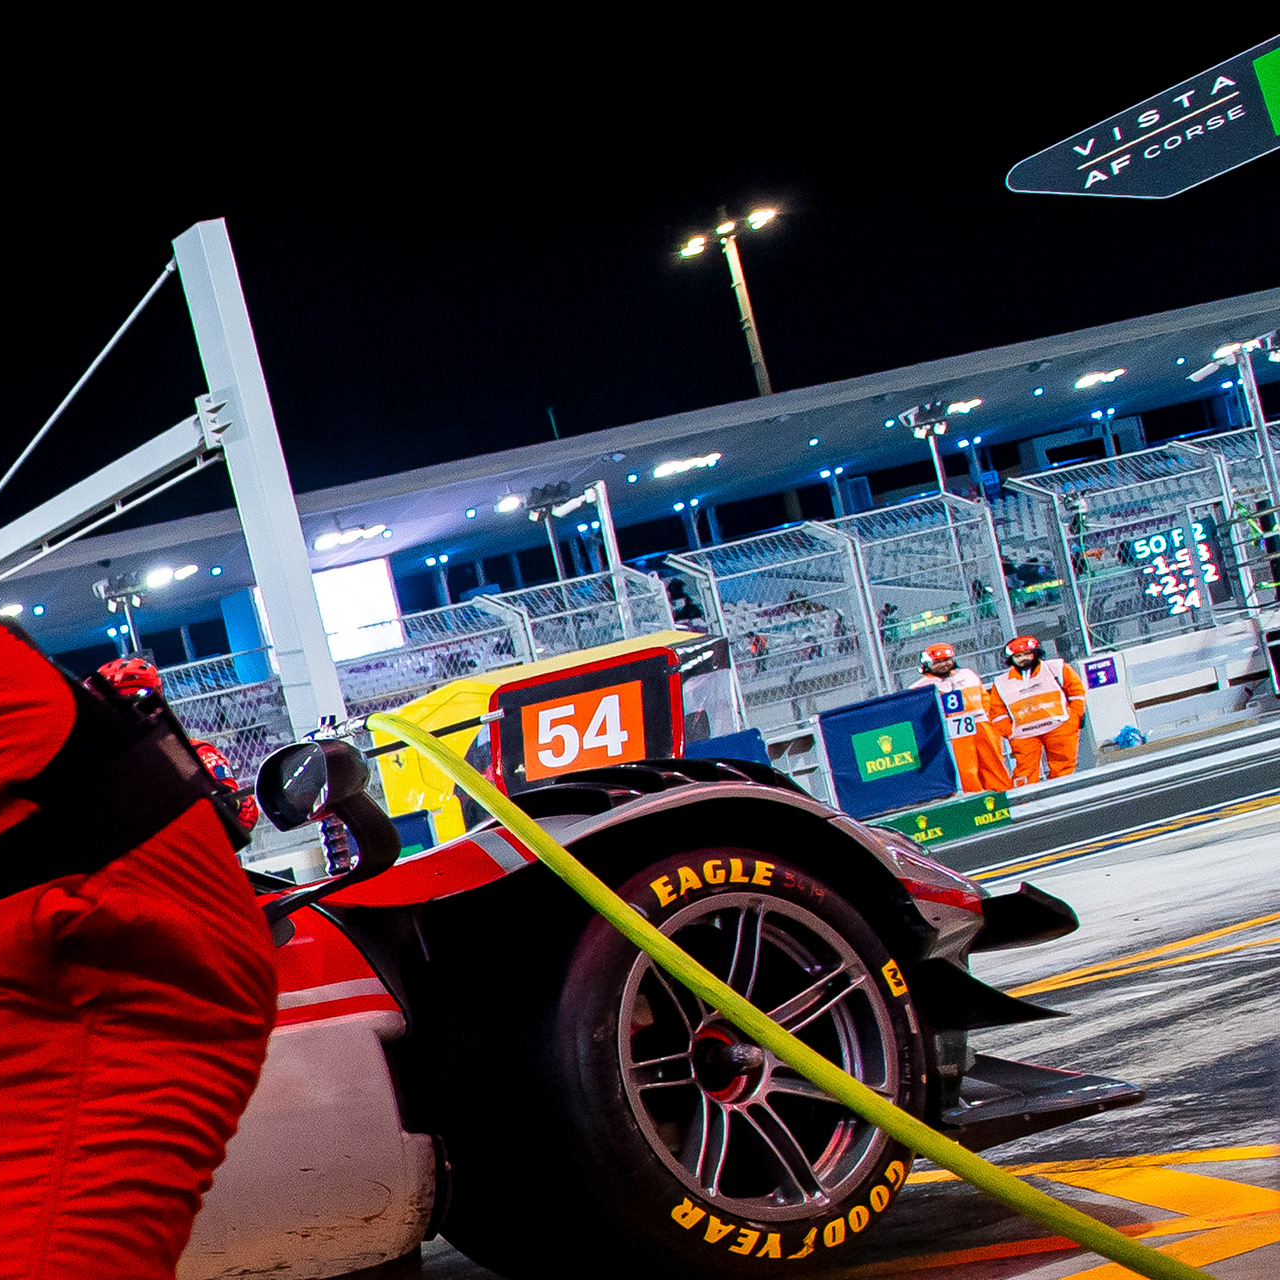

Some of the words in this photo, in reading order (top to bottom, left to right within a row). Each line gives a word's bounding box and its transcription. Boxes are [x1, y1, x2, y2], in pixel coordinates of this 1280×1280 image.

[1073, 75, 1237, 157] VISTA
[1083, 154, 1132, 189] AF
[1142, 104, 1247, 160] CORSE
[1134, 534, 1167, 559] 50
[1096, 671, 1107, 684] 3
[946, 691, 959, 710] 8
[537, 693, 629, 768] 54
[952, 716, 975, 735] 78
[865, 751, 915, 774] ROLEX
[973, 808, 1011, 827] ROLEX
[649, 857, 776, 908] EAGLE
[670, 1159, 906, 1260] GOODYEAR
